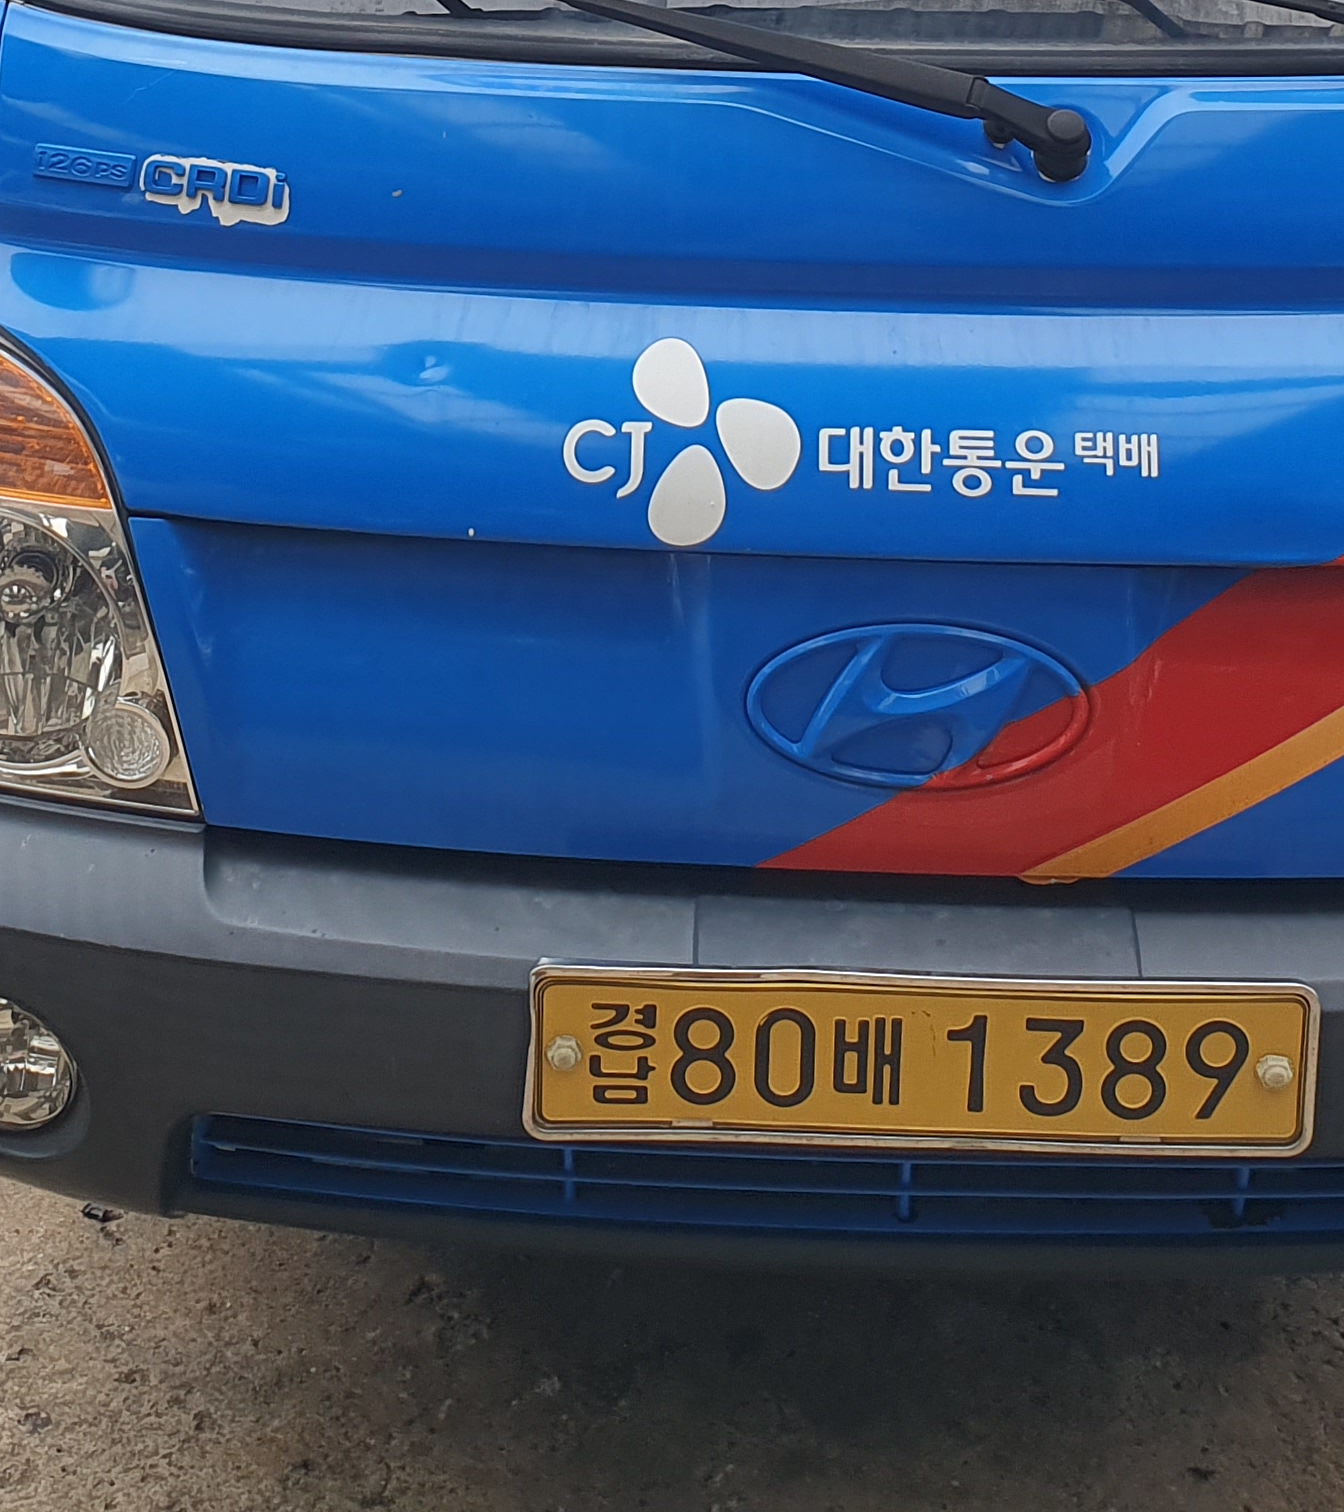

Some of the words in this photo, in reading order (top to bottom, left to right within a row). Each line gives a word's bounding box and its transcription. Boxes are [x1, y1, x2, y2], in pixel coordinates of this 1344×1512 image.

[35, 150, 129, 181] 126PS
[143, 158, 288, 210] CRDi
[562, 418, 654, 499] CJ
[818, 425, 1066, 498] 대한통운
[1073, 431, 1160, 478] 택배
[590, 1002, 657, 1106] 경남
[669, 1006, 905, 1108] 80배
[945, 1013, 1251, 1120] 1389
